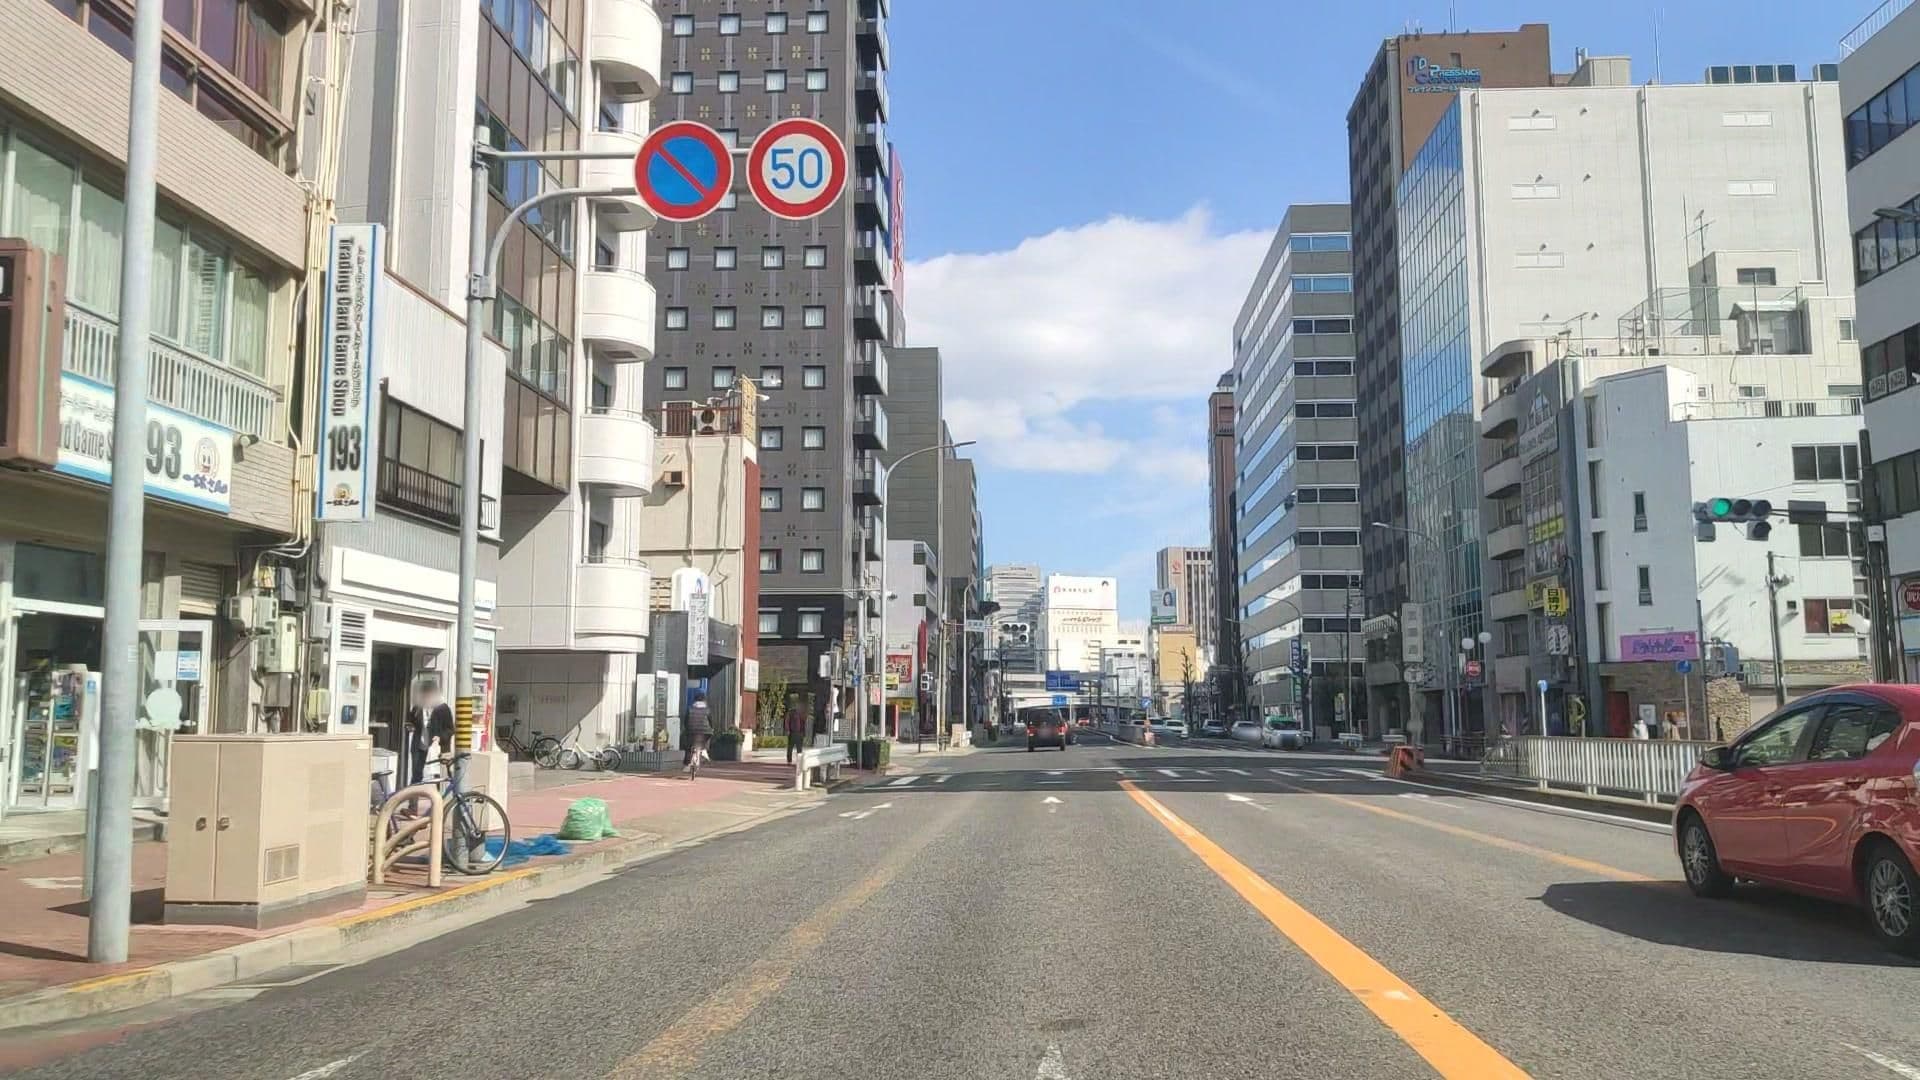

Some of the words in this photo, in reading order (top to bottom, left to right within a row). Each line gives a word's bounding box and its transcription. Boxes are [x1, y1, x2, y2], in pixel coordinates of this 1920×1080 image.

[770, 147, 823, 190] 50
[335, 237, 354, 294] Trading
[335, 296, 353, 333] Card
[333, 333, 351, 377] Game
[331, 380, 348, 417] Shop
[73, 421, 105, 459] Game
[327, 425, 362, 472] 193
